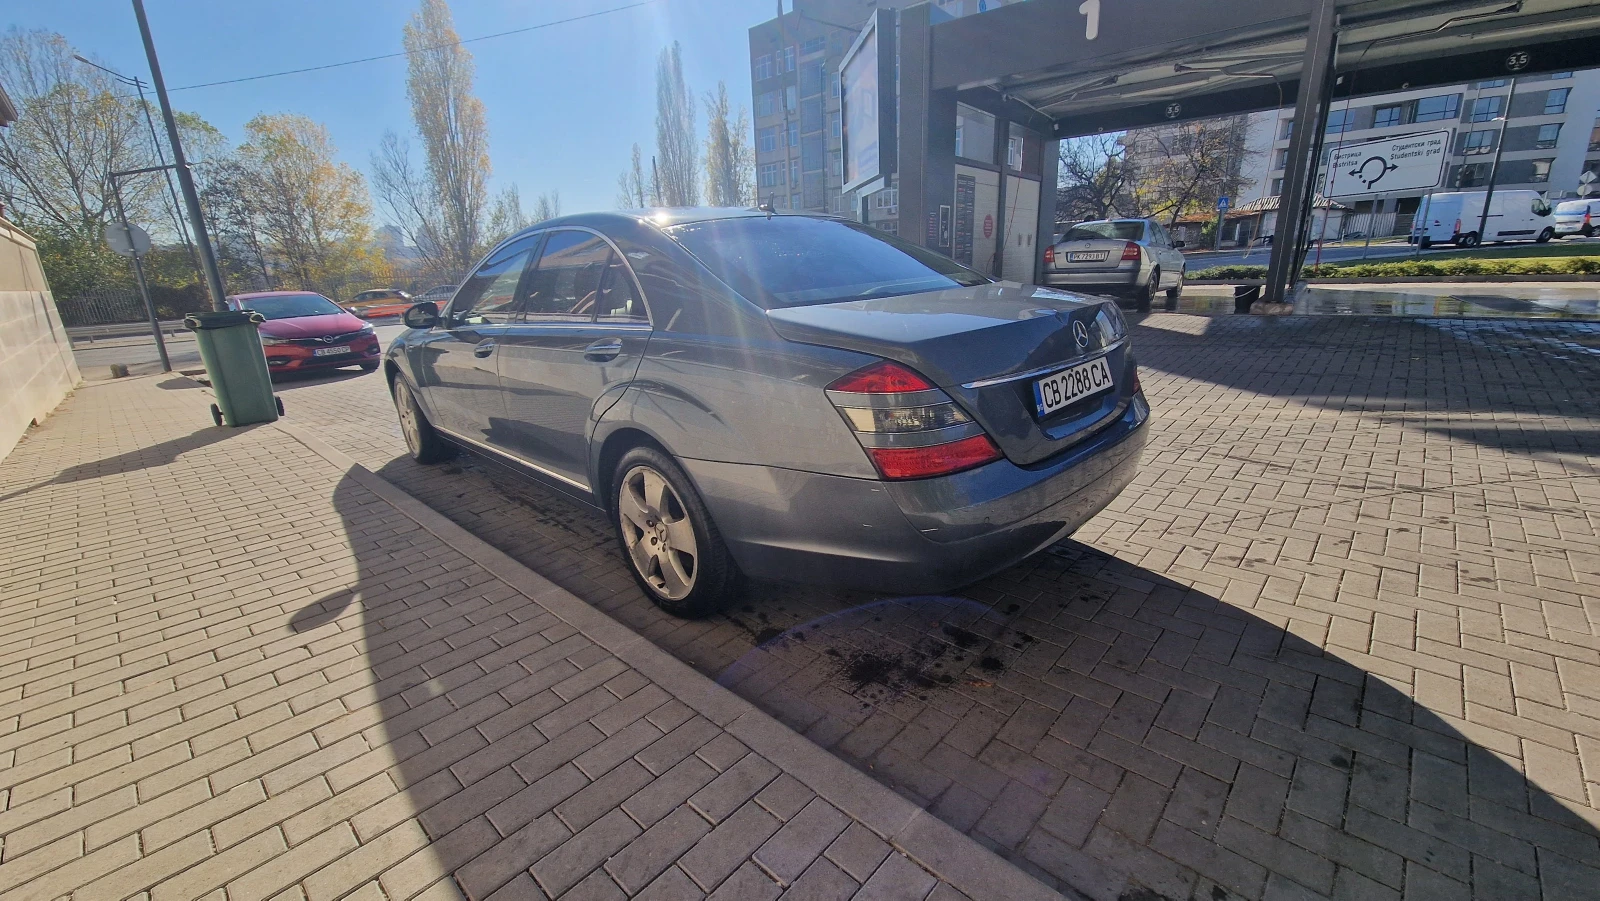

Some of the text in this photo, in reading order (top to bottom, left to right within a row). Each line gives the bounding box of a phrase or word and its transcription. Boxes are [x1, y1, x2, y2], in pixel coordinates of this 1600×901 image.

[1079, 0, 1100, 40] 1
[1390, 146, 1441, 160] Studentski grad
[1391, 139, 1441, 152] Студентски град
[1043, 361, 1110, 409] CB 2288 CA
